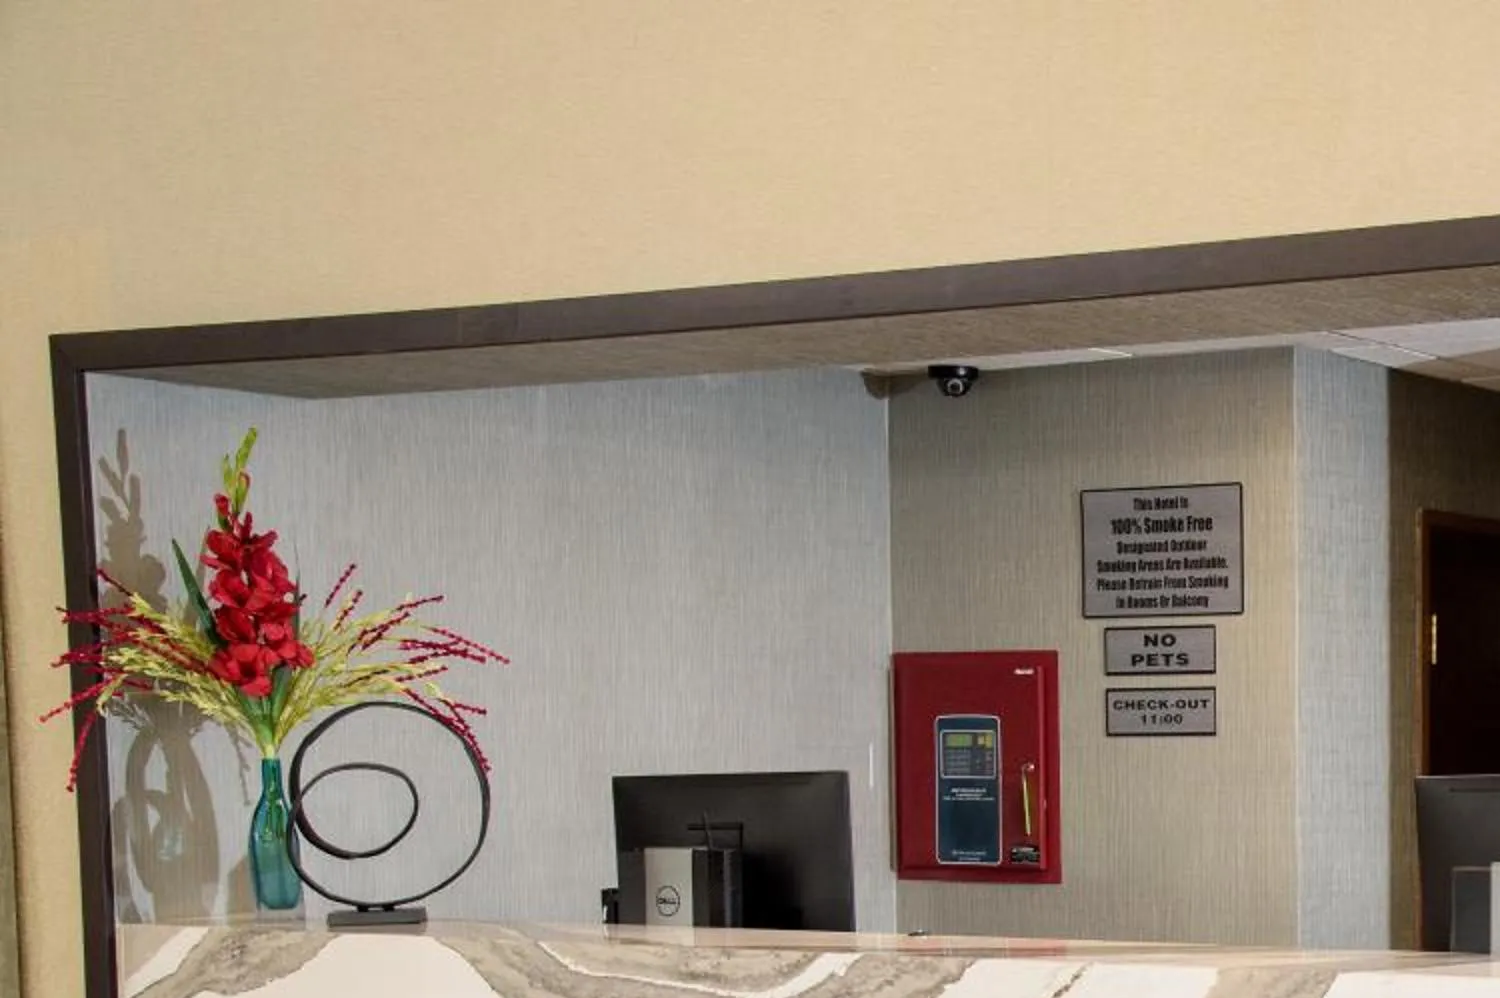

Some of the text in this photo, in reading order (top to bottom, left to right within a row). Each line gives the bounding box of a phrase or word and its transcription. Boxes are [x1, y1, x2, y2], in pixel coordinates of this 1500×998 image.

[1111, 515, 1213, 534] 100% Smoke Free
[1116, 540, 1207, 554] Designated Outdoor
[1097, 560, 1136, 573] Smoking
[1138, 559, 1164, 571] Areas
[1166, 558, 1181, 570] Are
[1097, 575, 1229, 590] Please Refrain From Smoking
[1128, 596, 1158, 608] Rooms
[1143, 633, 1177, 647] NO
[1131, 652, 1190, 667] PETS
[1112, 699, 1209, 711] CHECK-OUT
[1142, 714, 1184, 725] 11:00
